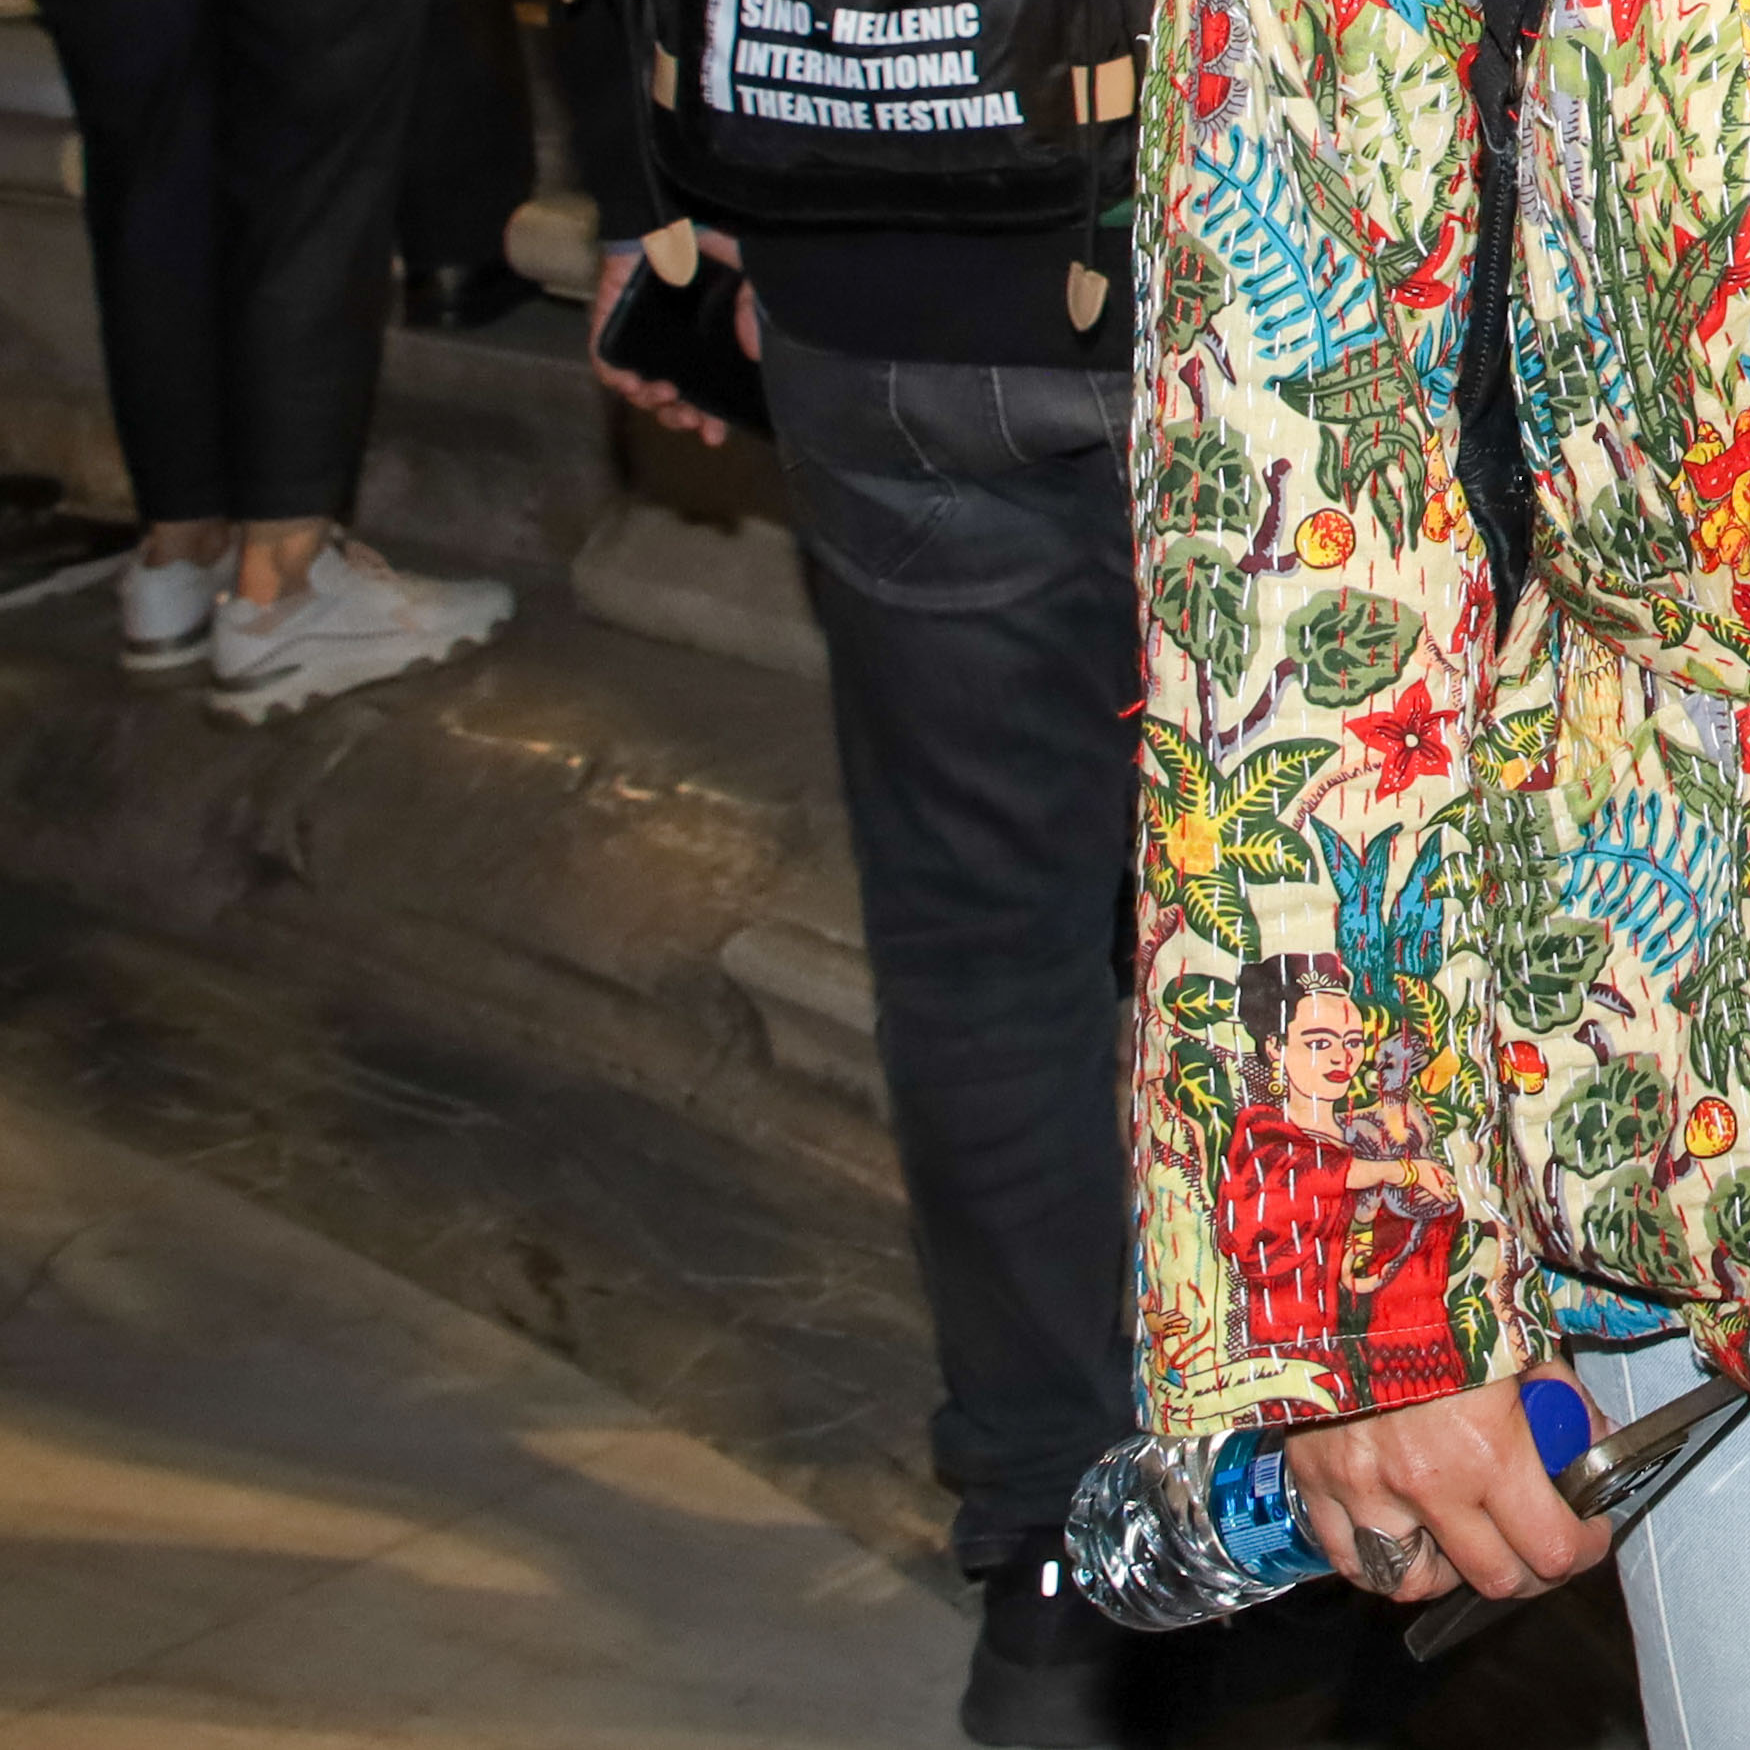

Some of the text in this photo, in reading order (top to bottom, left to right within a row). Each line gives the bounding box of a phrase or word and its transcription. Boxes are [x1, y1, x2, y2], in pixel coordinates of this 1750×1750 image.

[832, 3, 979, 45] HELLENIC
[735, 39, 979, 90] INTERNATIONAL
[736, 85, 1024, 131] THEATRE FESTIVAL
